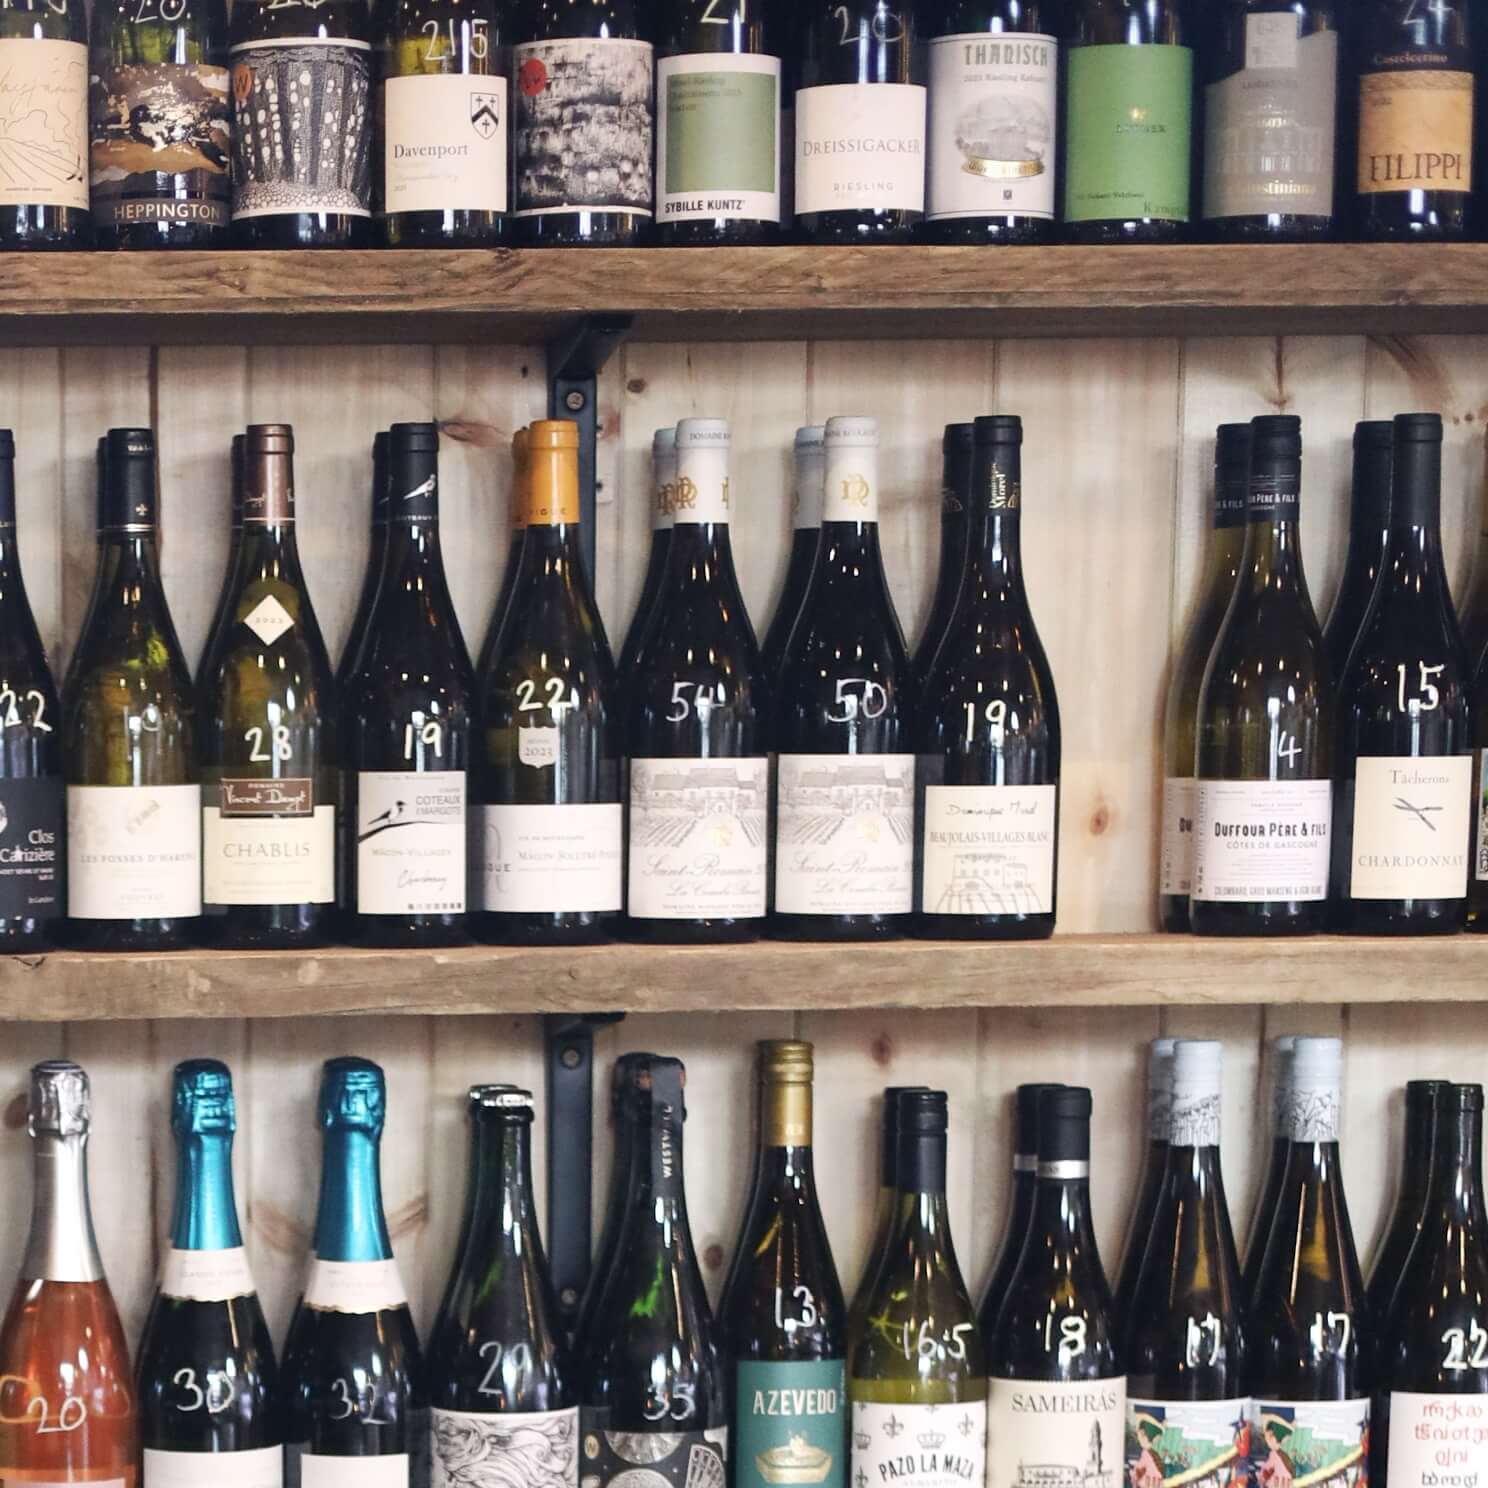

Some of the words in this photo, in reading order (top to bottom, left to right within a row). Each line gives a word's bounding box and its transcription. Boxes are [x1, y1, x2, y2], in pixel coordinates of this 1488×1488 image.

[964, 43, 1049, 66] THANISCH
[393, 143, 469, 161] Davenport
[802, 138, 922, 157] DREISSIGACKER
[1369, 152, 1462, 183] FILIPPI
[833, 182, 894, 192] RIESLING
[113, 202, 221, 219] HEPPINGTON
[665, 200, 704, 214] SYBILLE
[707, 199, 743, 211] KUNTZ
[516, 677, 573, 712] 22
[1397, 660, 1446, 713] 15
[964, 700, 1009, 743] 19
[244, 726, 293, 762] 28
[403, 722, 443, 761] 19
[415, 795, 461, 806] COTEAUX
[27, 828, 55, 845] Clos
[1301, 821, 1309, 837] &
[222, 842, 312, 859] CHABLIS
[752, 1388, 838, 1418] AZEVEDO
[1010, 1390, 1118, 1413] SAMEIRÁS
[26, 1395, 87, 1435] 20
[878, 1457, 917, 1482] PAZO
[919, 1454, 940, 1474] LA
[941, 1453, 976, 1482] MAZA
